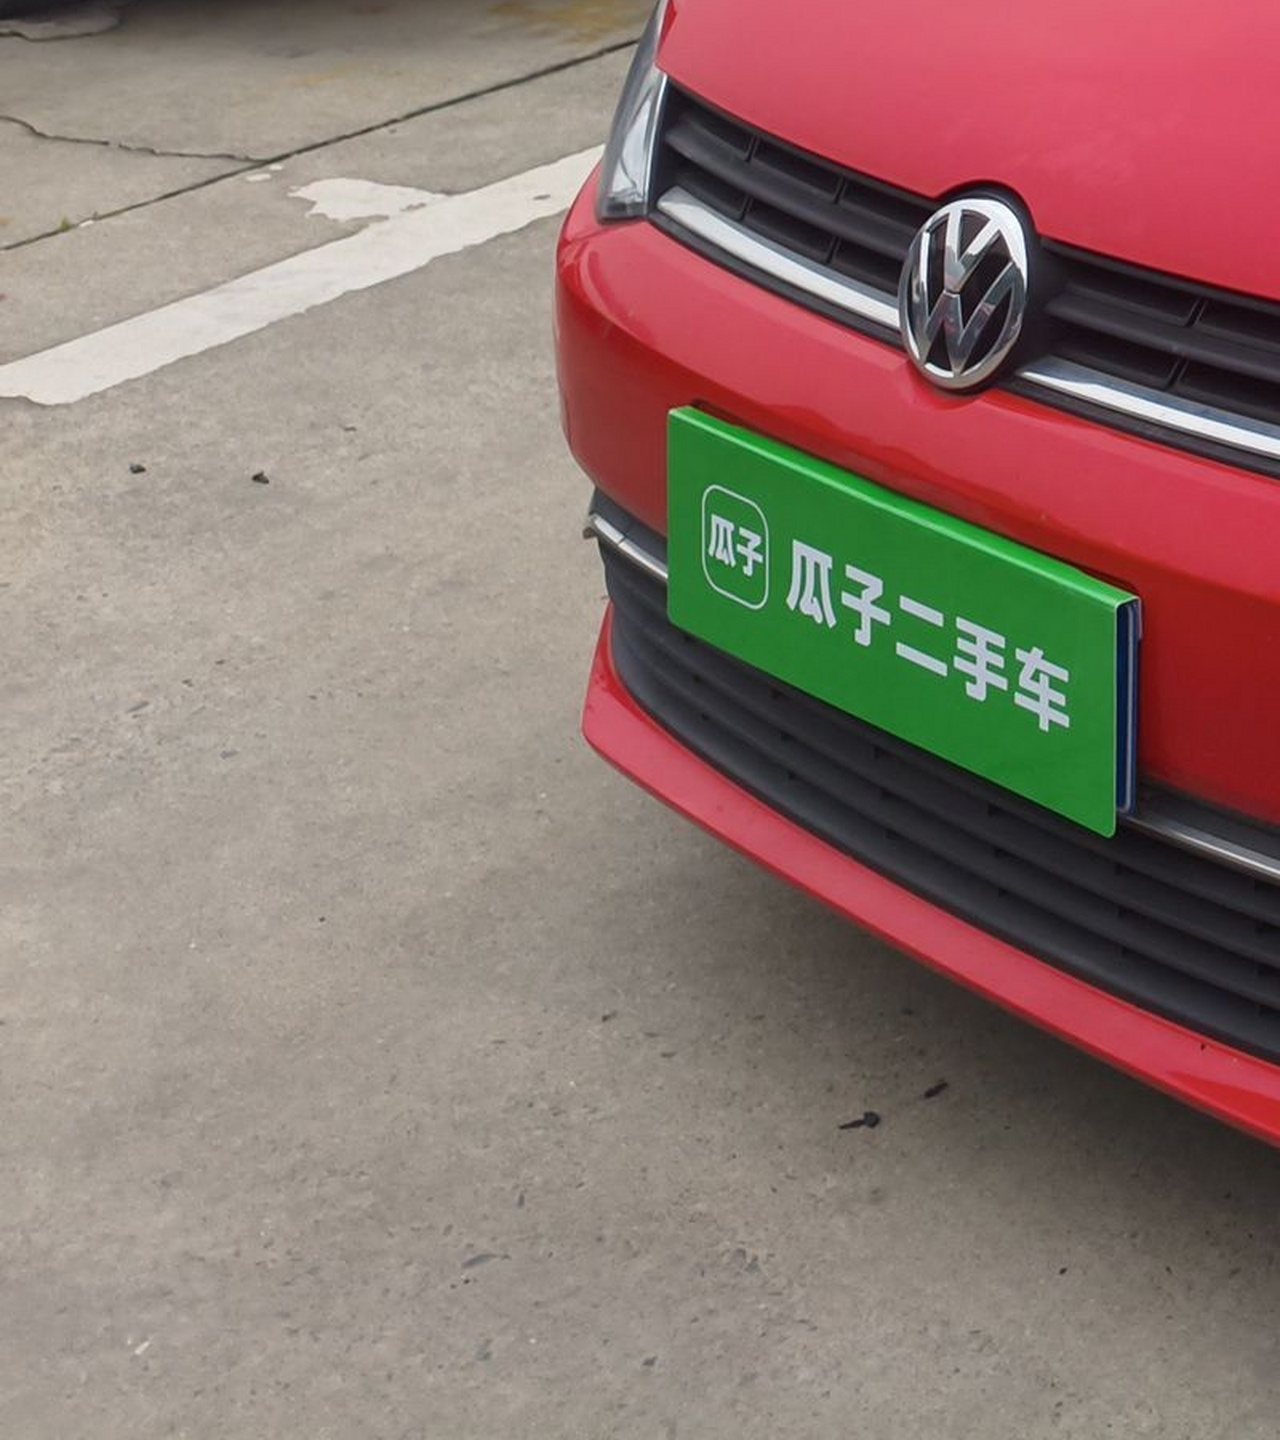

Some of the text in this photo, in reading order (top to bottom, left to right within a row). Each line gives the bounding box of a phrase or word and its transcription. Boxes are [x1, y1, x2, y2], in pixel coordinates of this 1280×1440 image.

[708, 513, 764, 577] 瓜子
[786, 538, 1071, 734] 瓜子二手车
